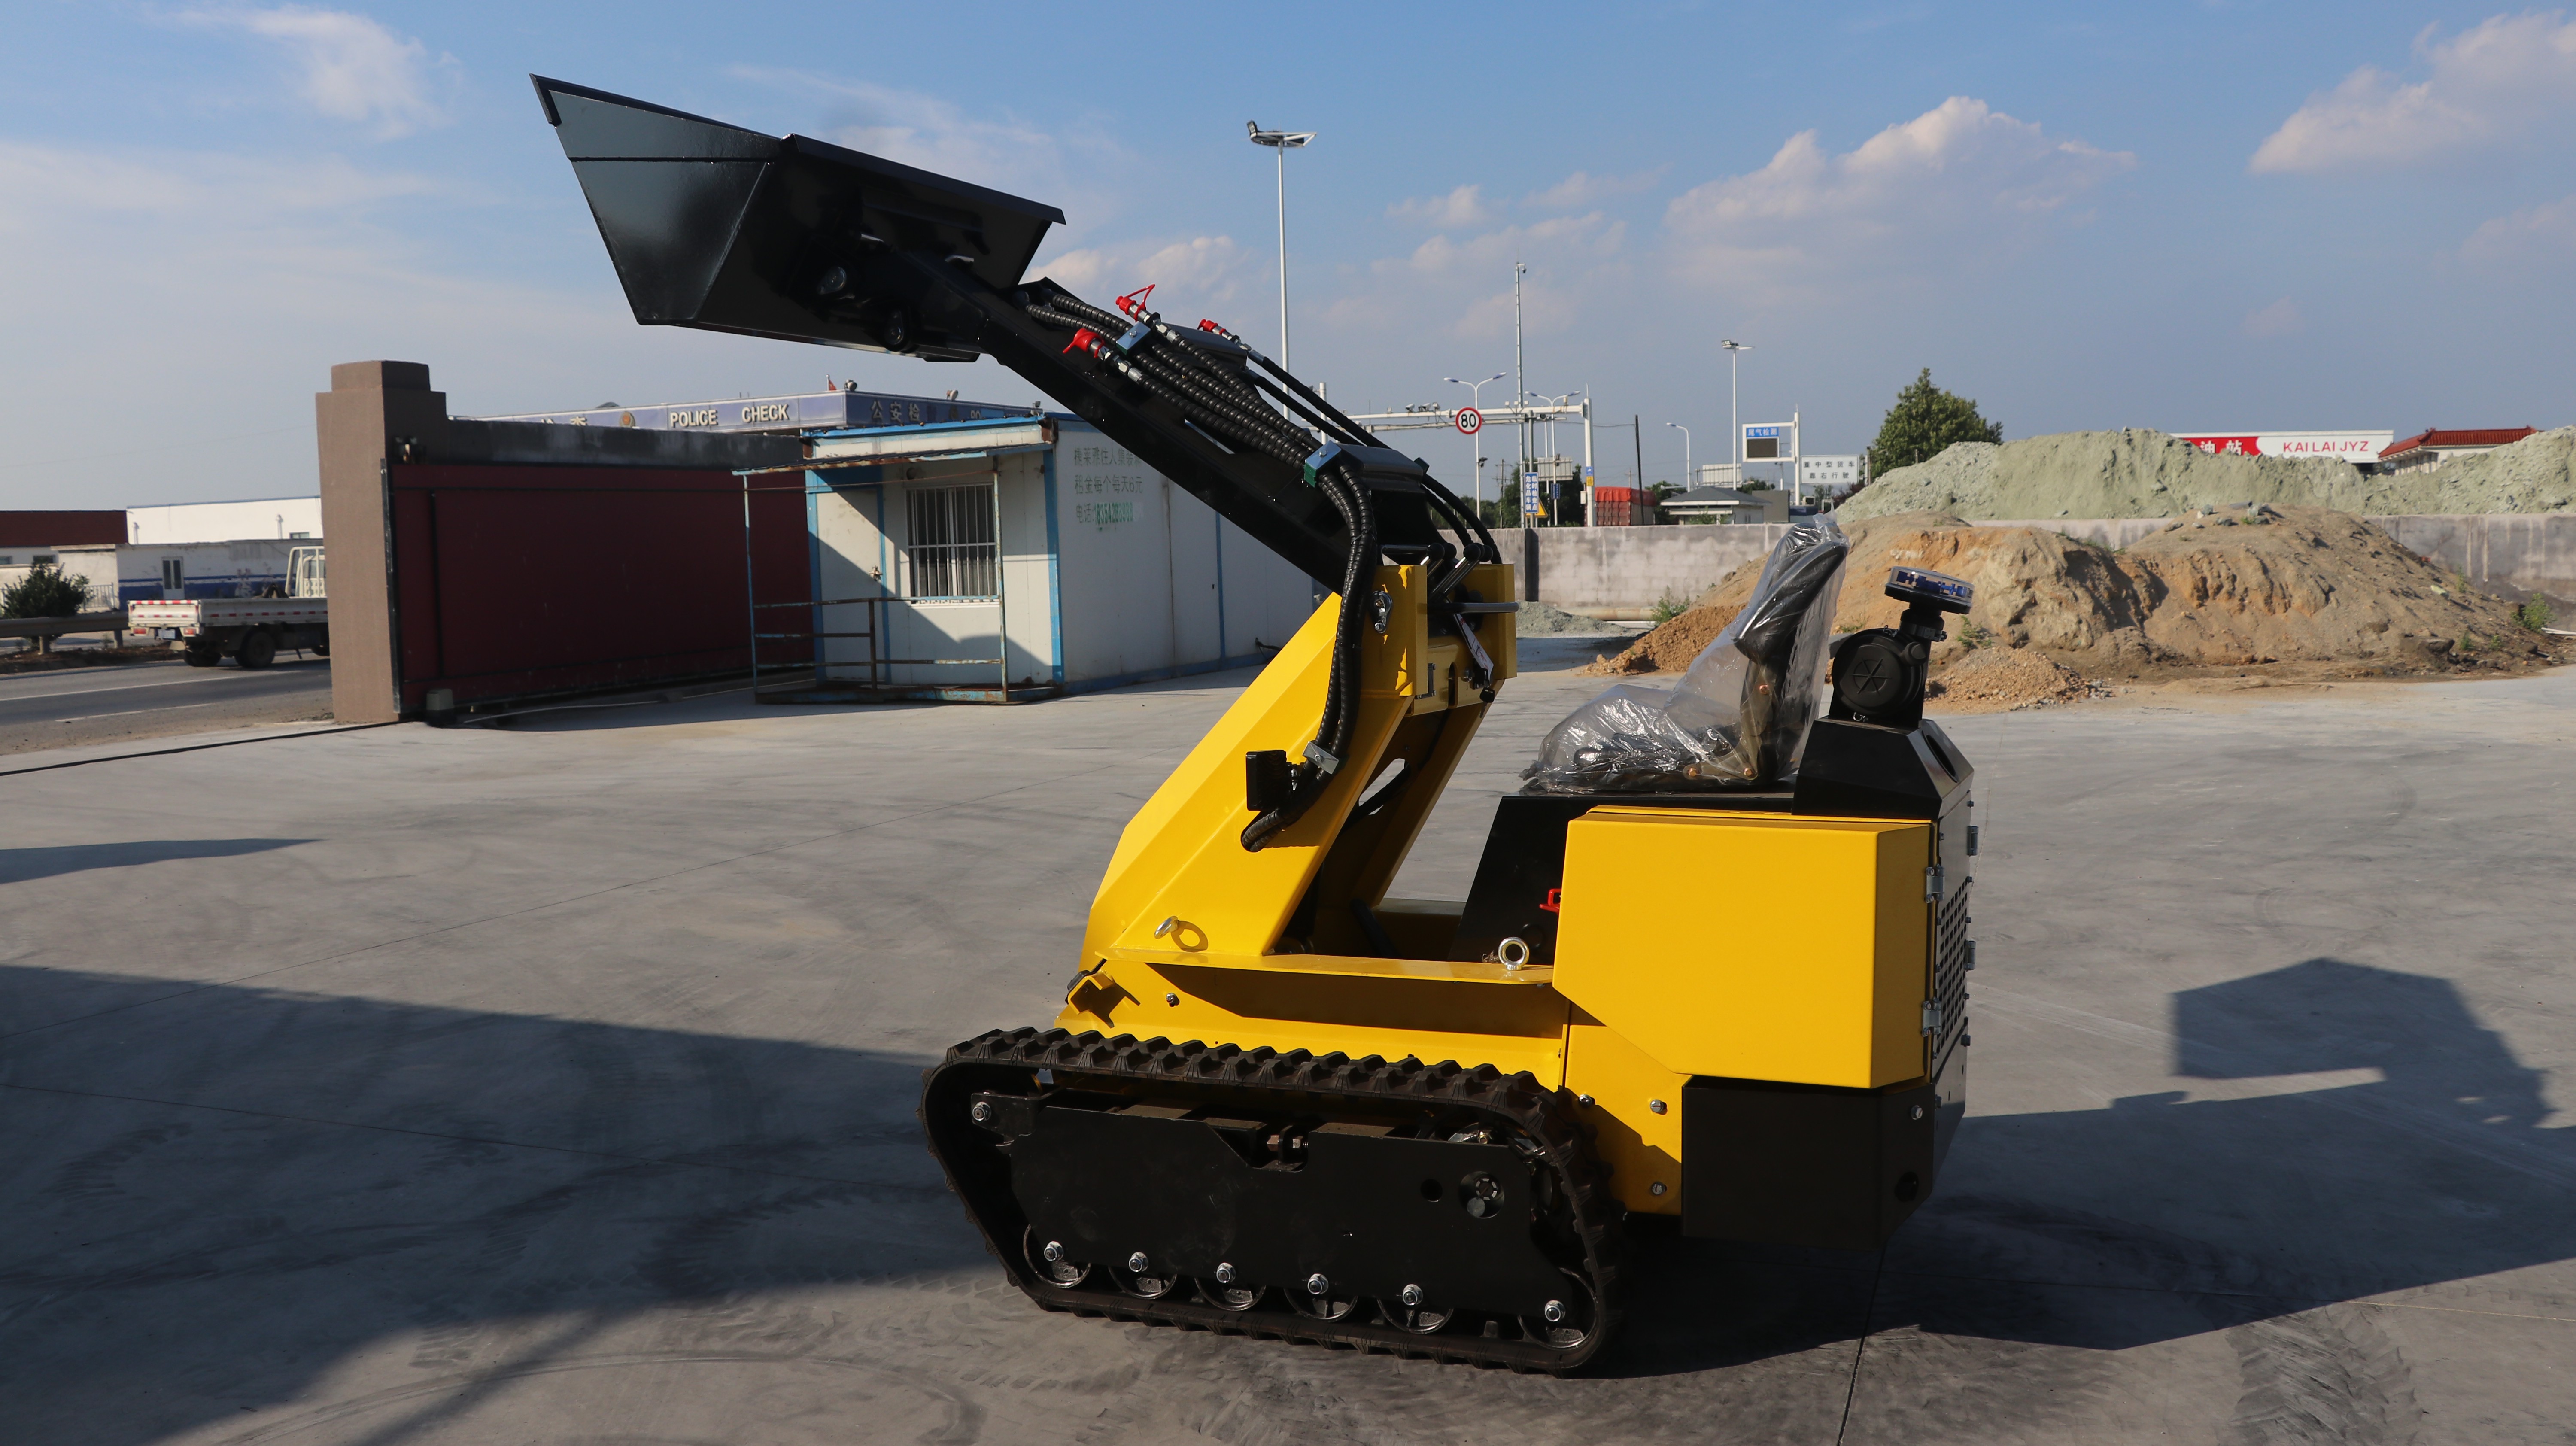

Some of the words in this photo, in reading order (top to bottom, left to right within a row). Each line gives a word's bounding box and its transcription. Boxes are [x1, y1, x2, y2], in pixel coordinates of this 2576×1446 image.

[670, 409, 718, 428] POLICE
[742, 404, 790, 423] CHECK
[1461, 413, 1476, 428] 80
[1748, 428, 1777, 436] 尾气检测
[2340, 441, 2369, 451] JYZ
[1075, 474, 1143, 494] 租金每个每天6元
